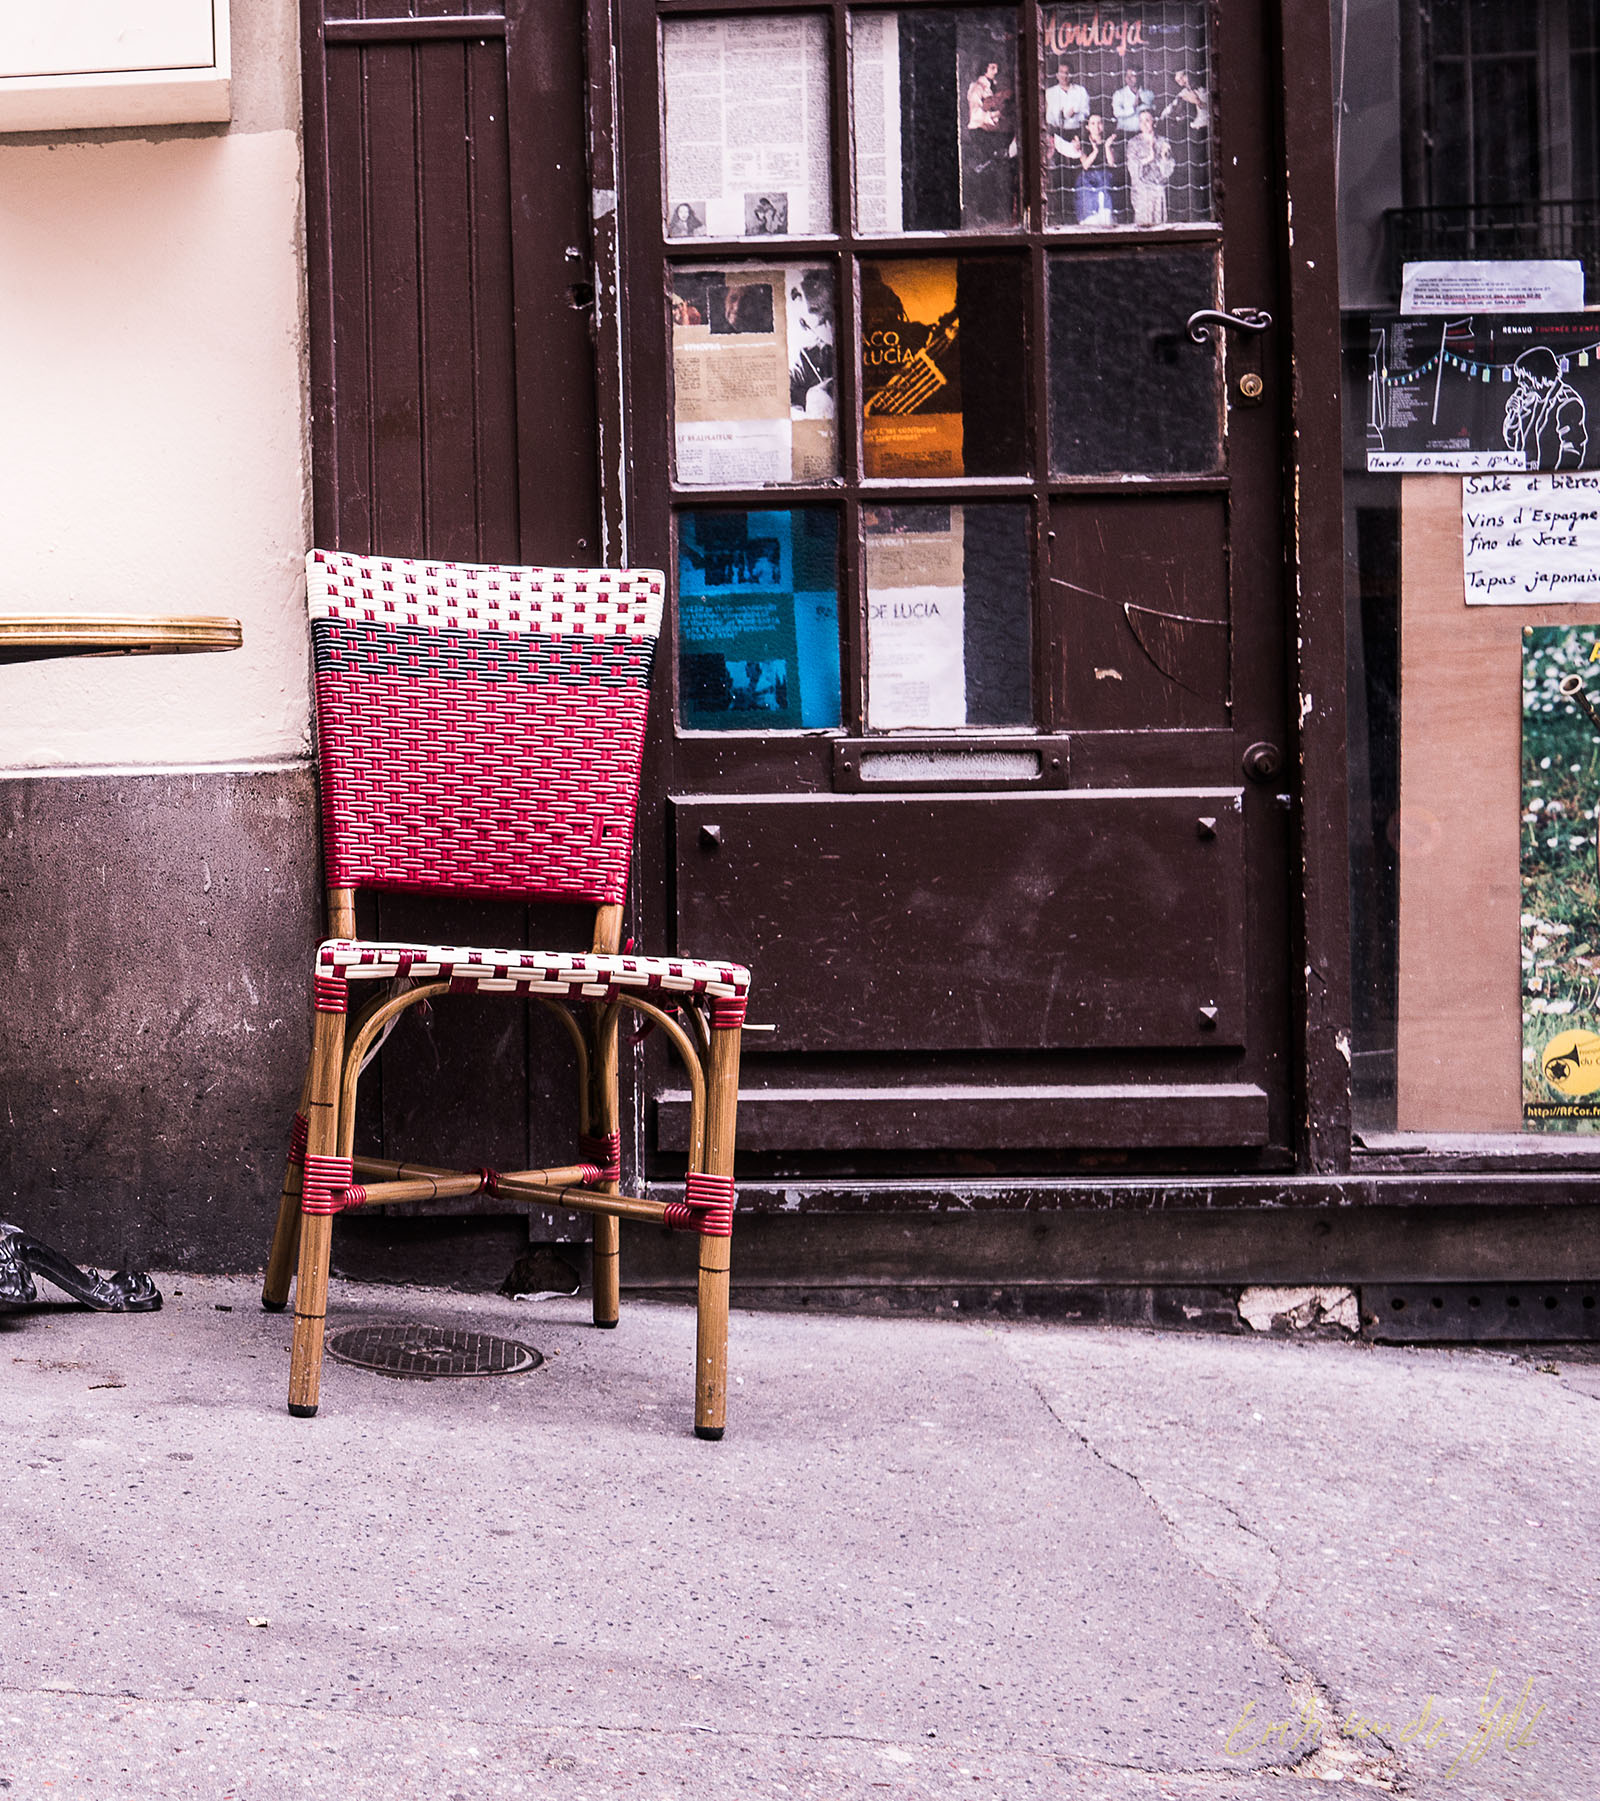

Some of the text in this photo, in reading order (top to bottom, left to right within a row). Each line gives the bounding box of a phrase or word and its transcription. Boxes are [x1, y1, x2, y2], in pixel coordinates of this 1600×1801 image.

[1502, 325, 1533, 334] RENAUD
[1369, 457, 1405, 468] Mardi
[1465, 475, 1512, 495] Saké
[1526, 477, 1539, 491] et
[1466, 512, 1505, 528] Vins
[1466, 531, 1579, 557] fino de Jerez
[1466, 568, 1600, 594] Tapas japonais
